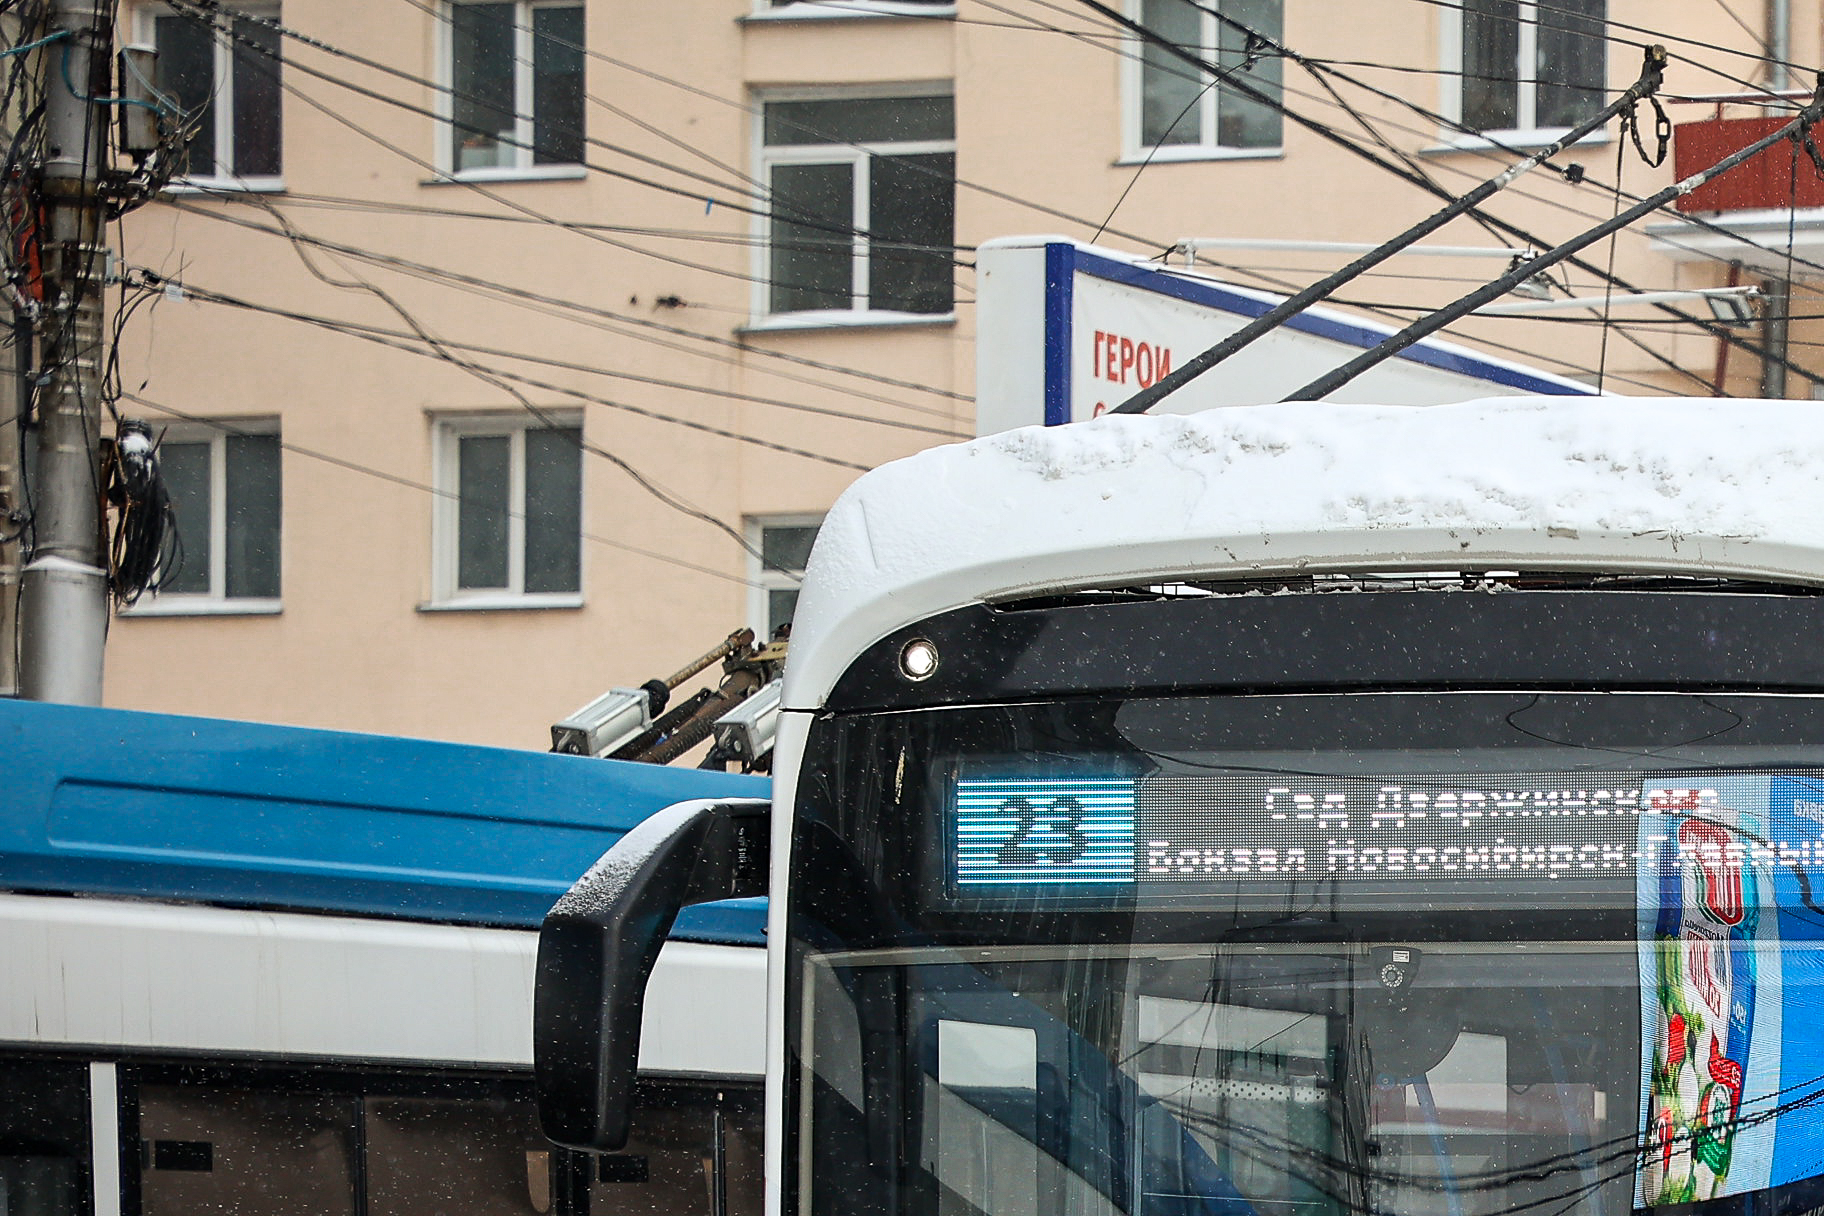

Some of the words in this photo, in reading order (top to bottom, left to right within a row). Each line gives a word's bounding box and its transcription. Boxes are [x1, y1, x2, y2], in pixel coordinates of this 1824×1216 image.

[1094, 330, 1169, 389] ГЕРОИ
[998, 796, 1087, 866] 23
[1265, 787, 1349, 828] Сад
[1371, 786, 1718, 828] Дзержинского
[1149, 841, 1305, 872] Вокзал
